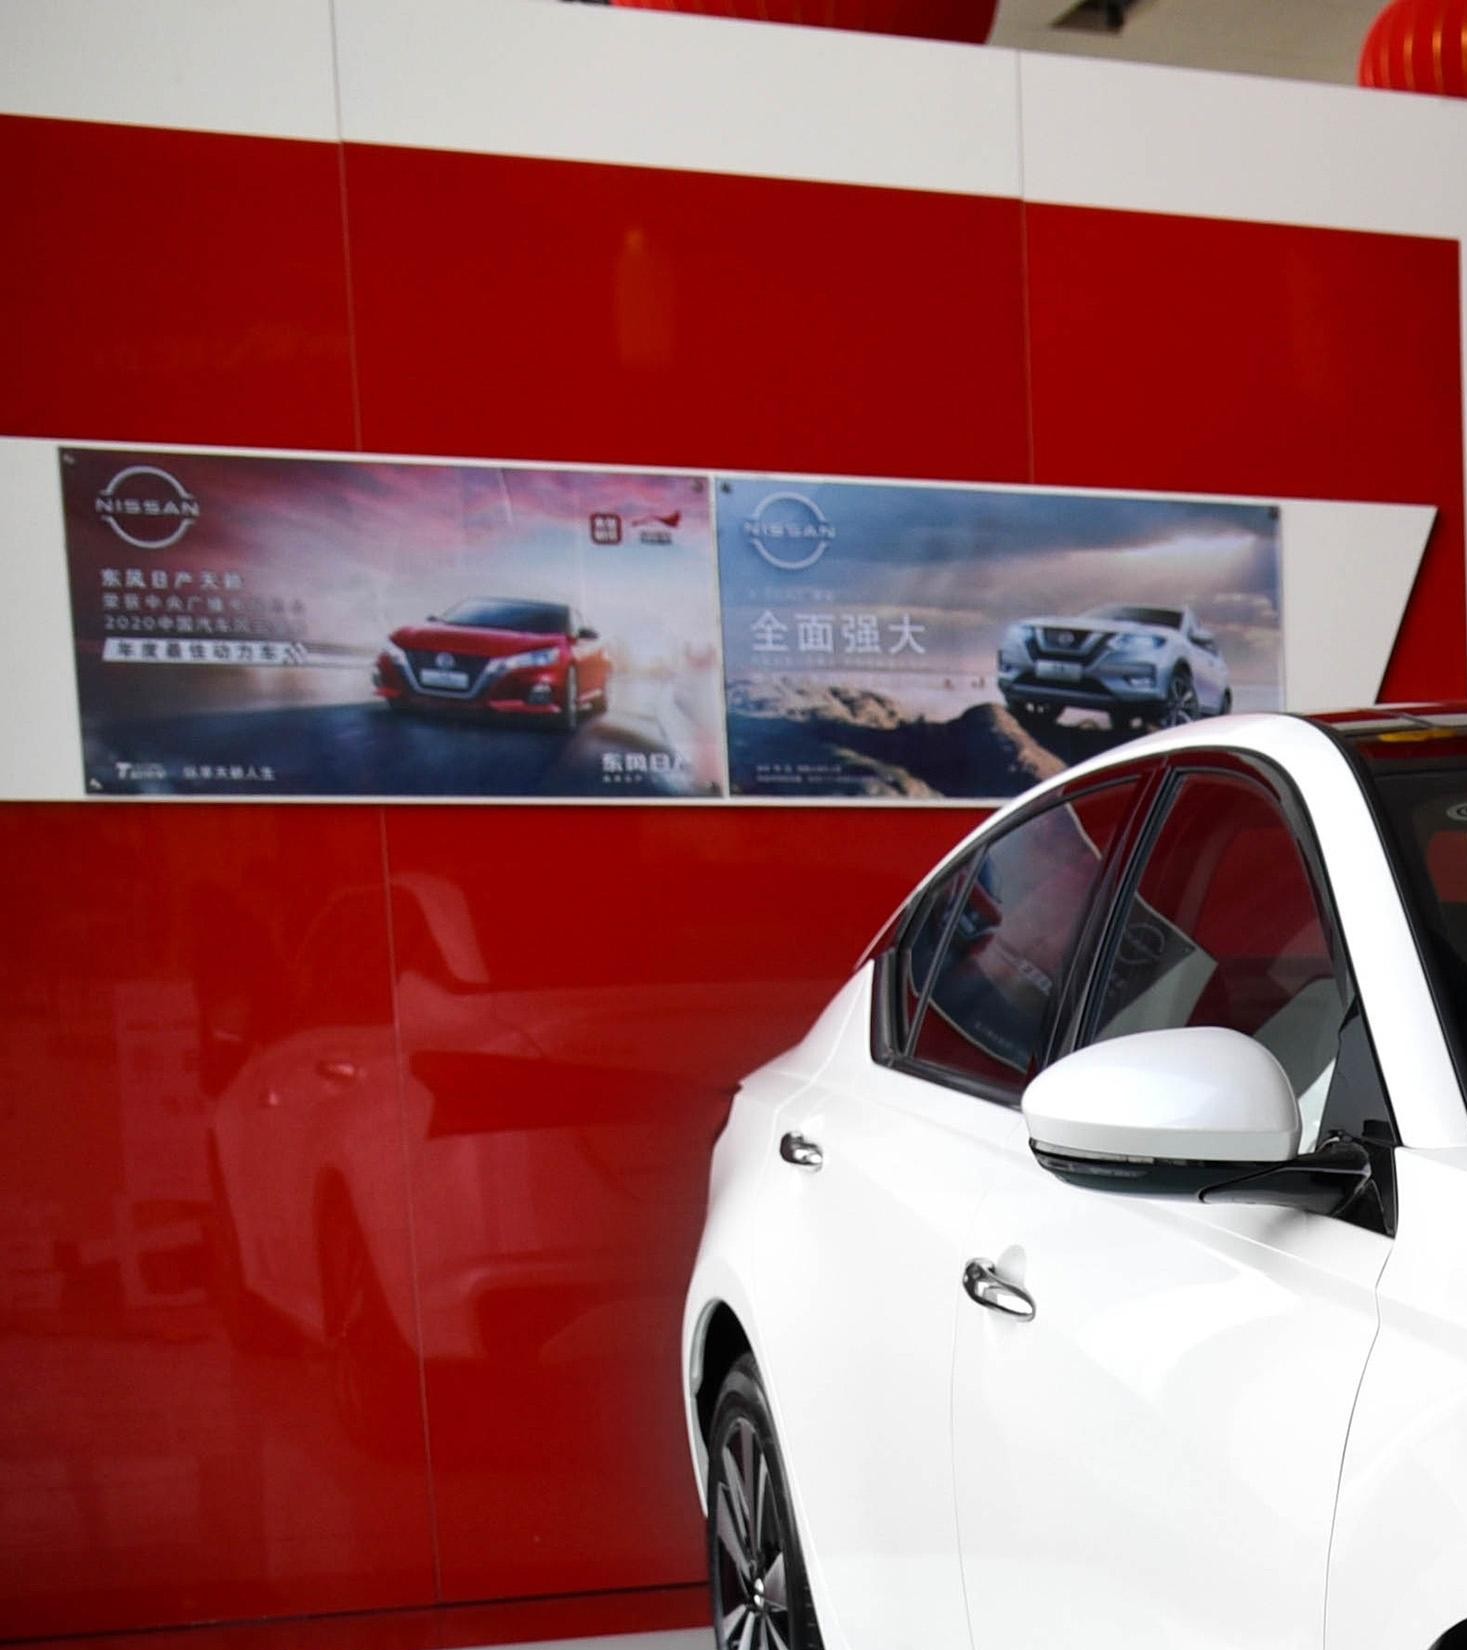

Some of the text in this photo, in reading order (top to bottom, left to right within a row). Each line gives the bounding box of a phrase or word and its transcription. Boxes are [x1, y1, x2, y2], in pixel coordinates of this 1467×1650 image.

[95, 497, 200, 517] NISSAN
[744, 521, 836, 540] NISSAN
[752, 609, 926, 655] 全面强大
